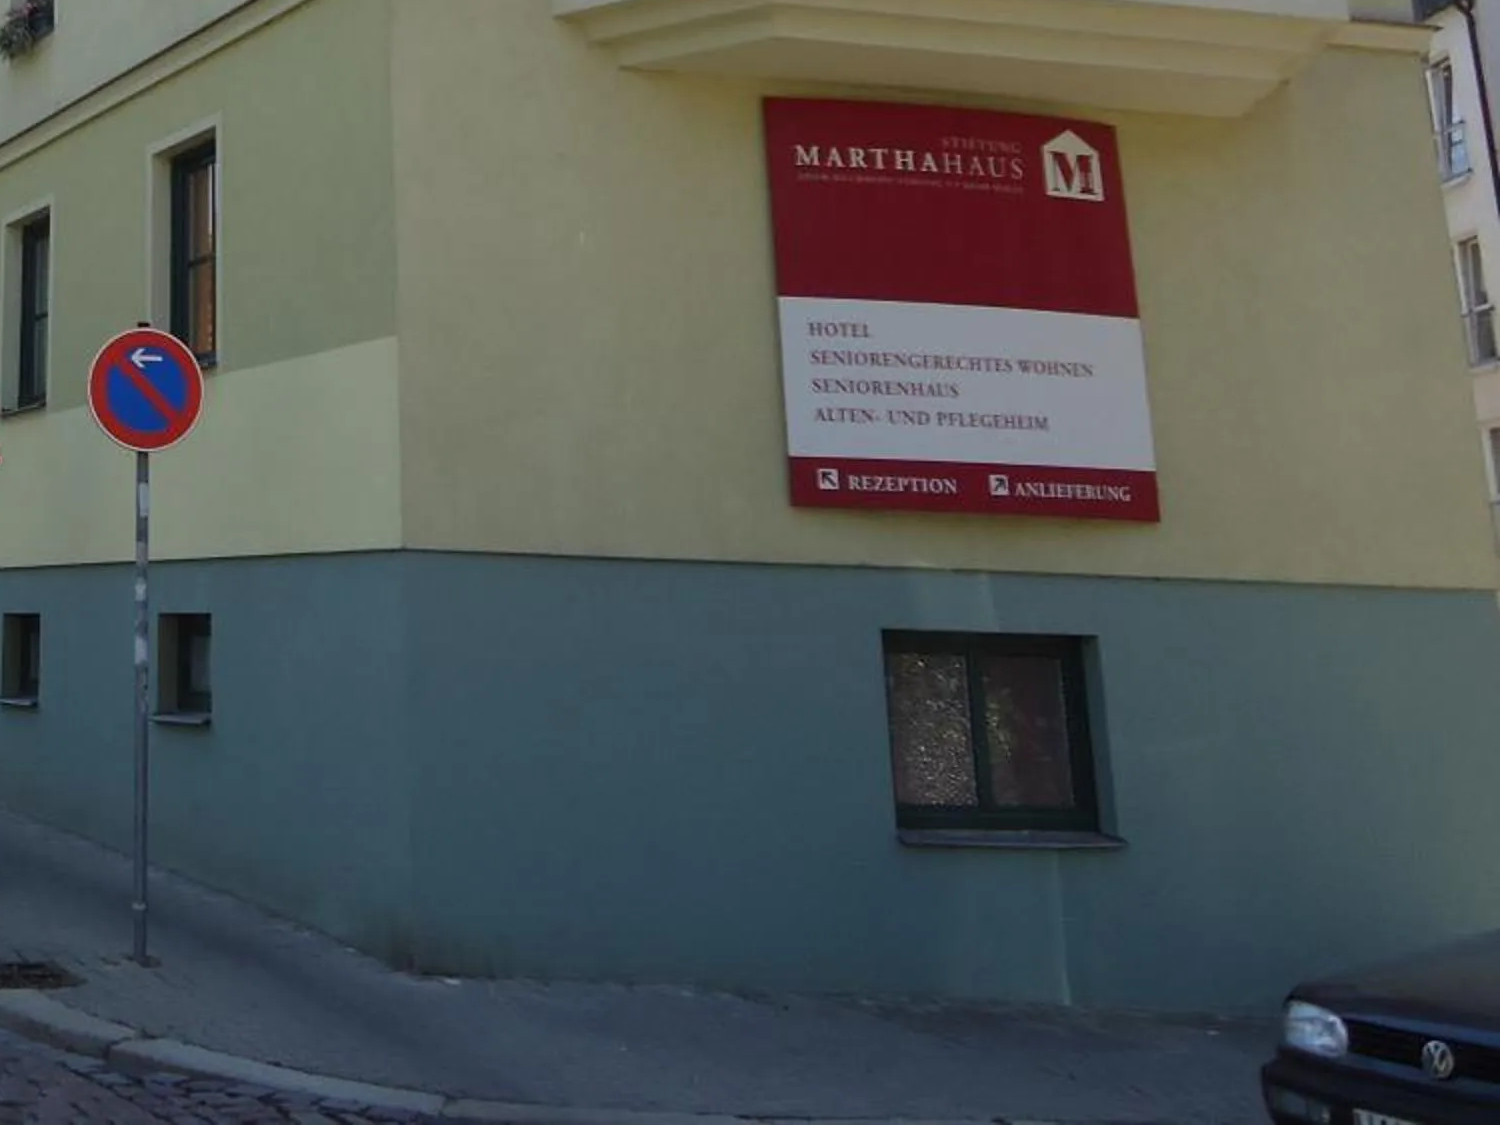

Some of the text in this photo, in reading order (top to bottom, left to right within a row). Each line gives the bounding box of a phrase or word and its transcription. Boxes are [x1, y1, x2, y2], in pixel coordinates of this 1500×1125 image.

[941, 136, 1022, 154] STIFTUNG
[794, 144, 1024, 180] MARTHAHAUS
[808, 322, 871, 339] HOTEL
[810, 350, 1094, 377] SENIORENGERECHTES WOHNEN
[811, 378, 960, 398] SENIORENHAUS
[814, 407, 1049, 432] ALTEN- UND PFLEGEHEIM
[848, 474, 958, 494] REZEPTION
[1015, 484, 1132, 503] ANLIEFERUNG
